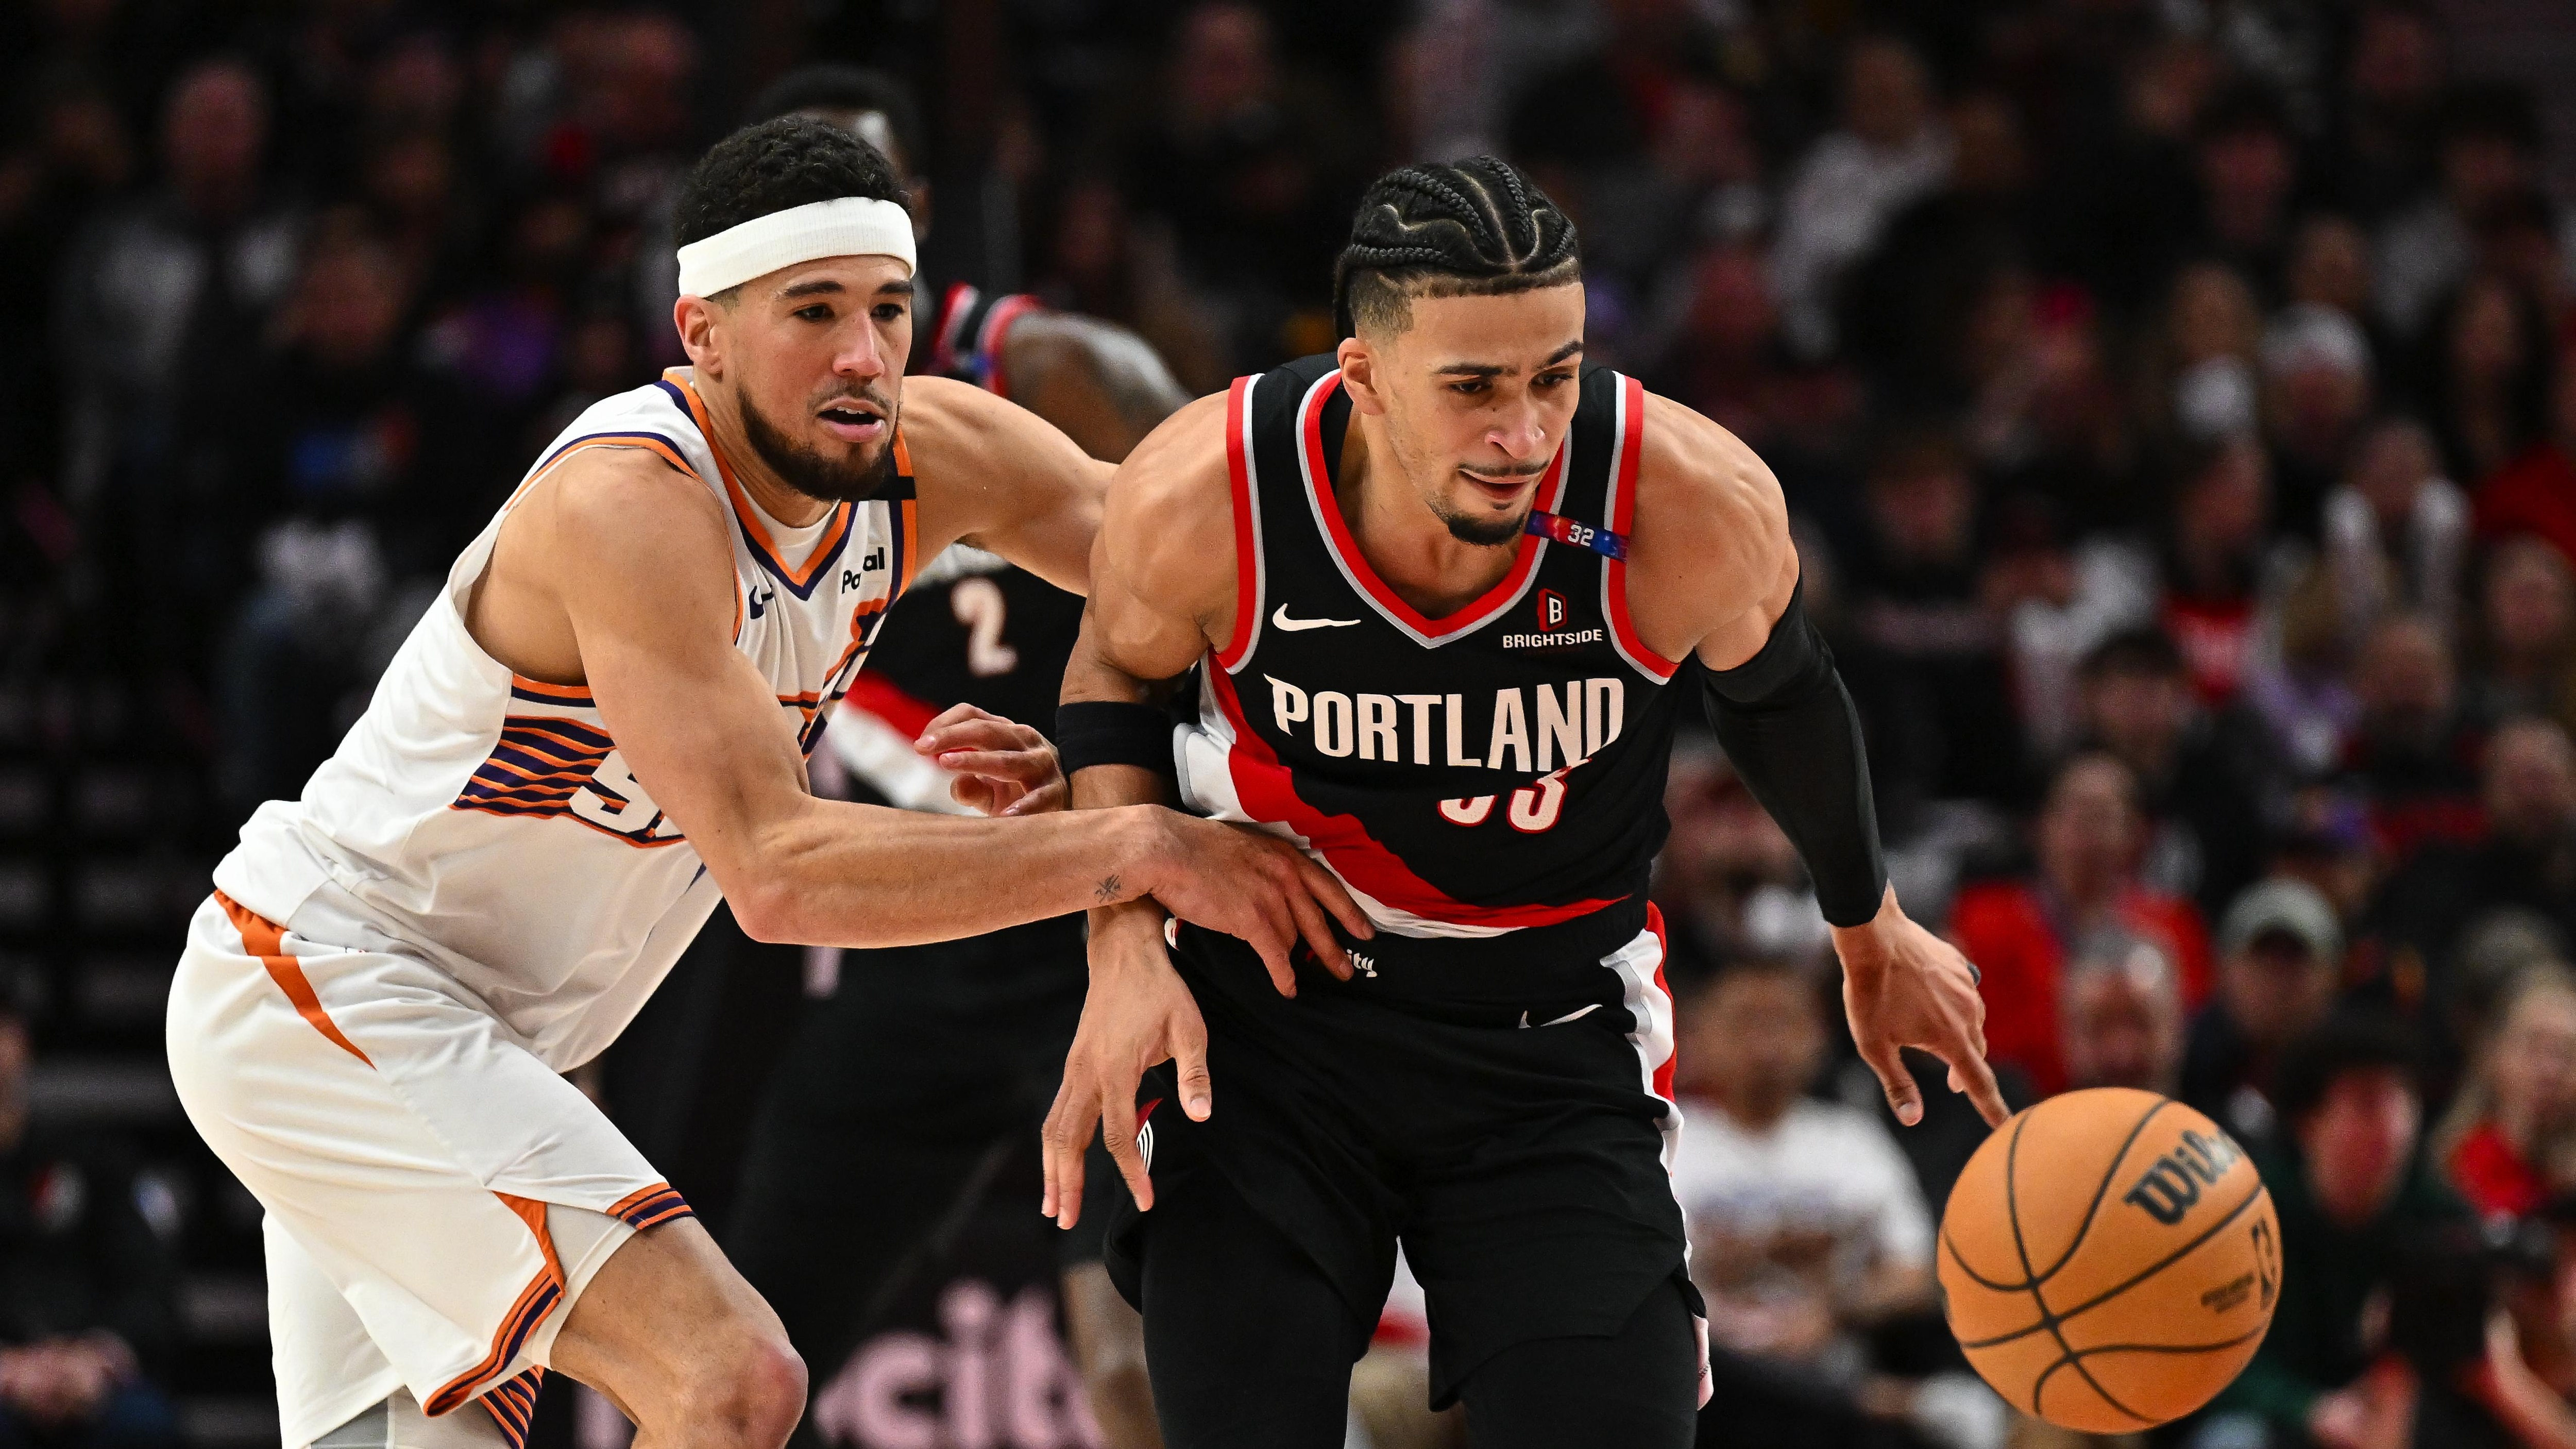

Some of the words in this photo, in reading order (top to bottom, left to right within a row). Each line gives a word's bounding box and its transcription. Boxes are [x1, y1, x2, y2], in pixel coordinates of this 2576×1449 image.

[1567, 524, 1595, 547] 32
[1548, 596, 1563, 625] B
[951, 575, 1019, 677] 2
[1502, 629, 1603, 649] BRIGHTSIDE
[1264, 673, 1624, 772] PORTLAND
[1346, 949, 1378, 978] ity
